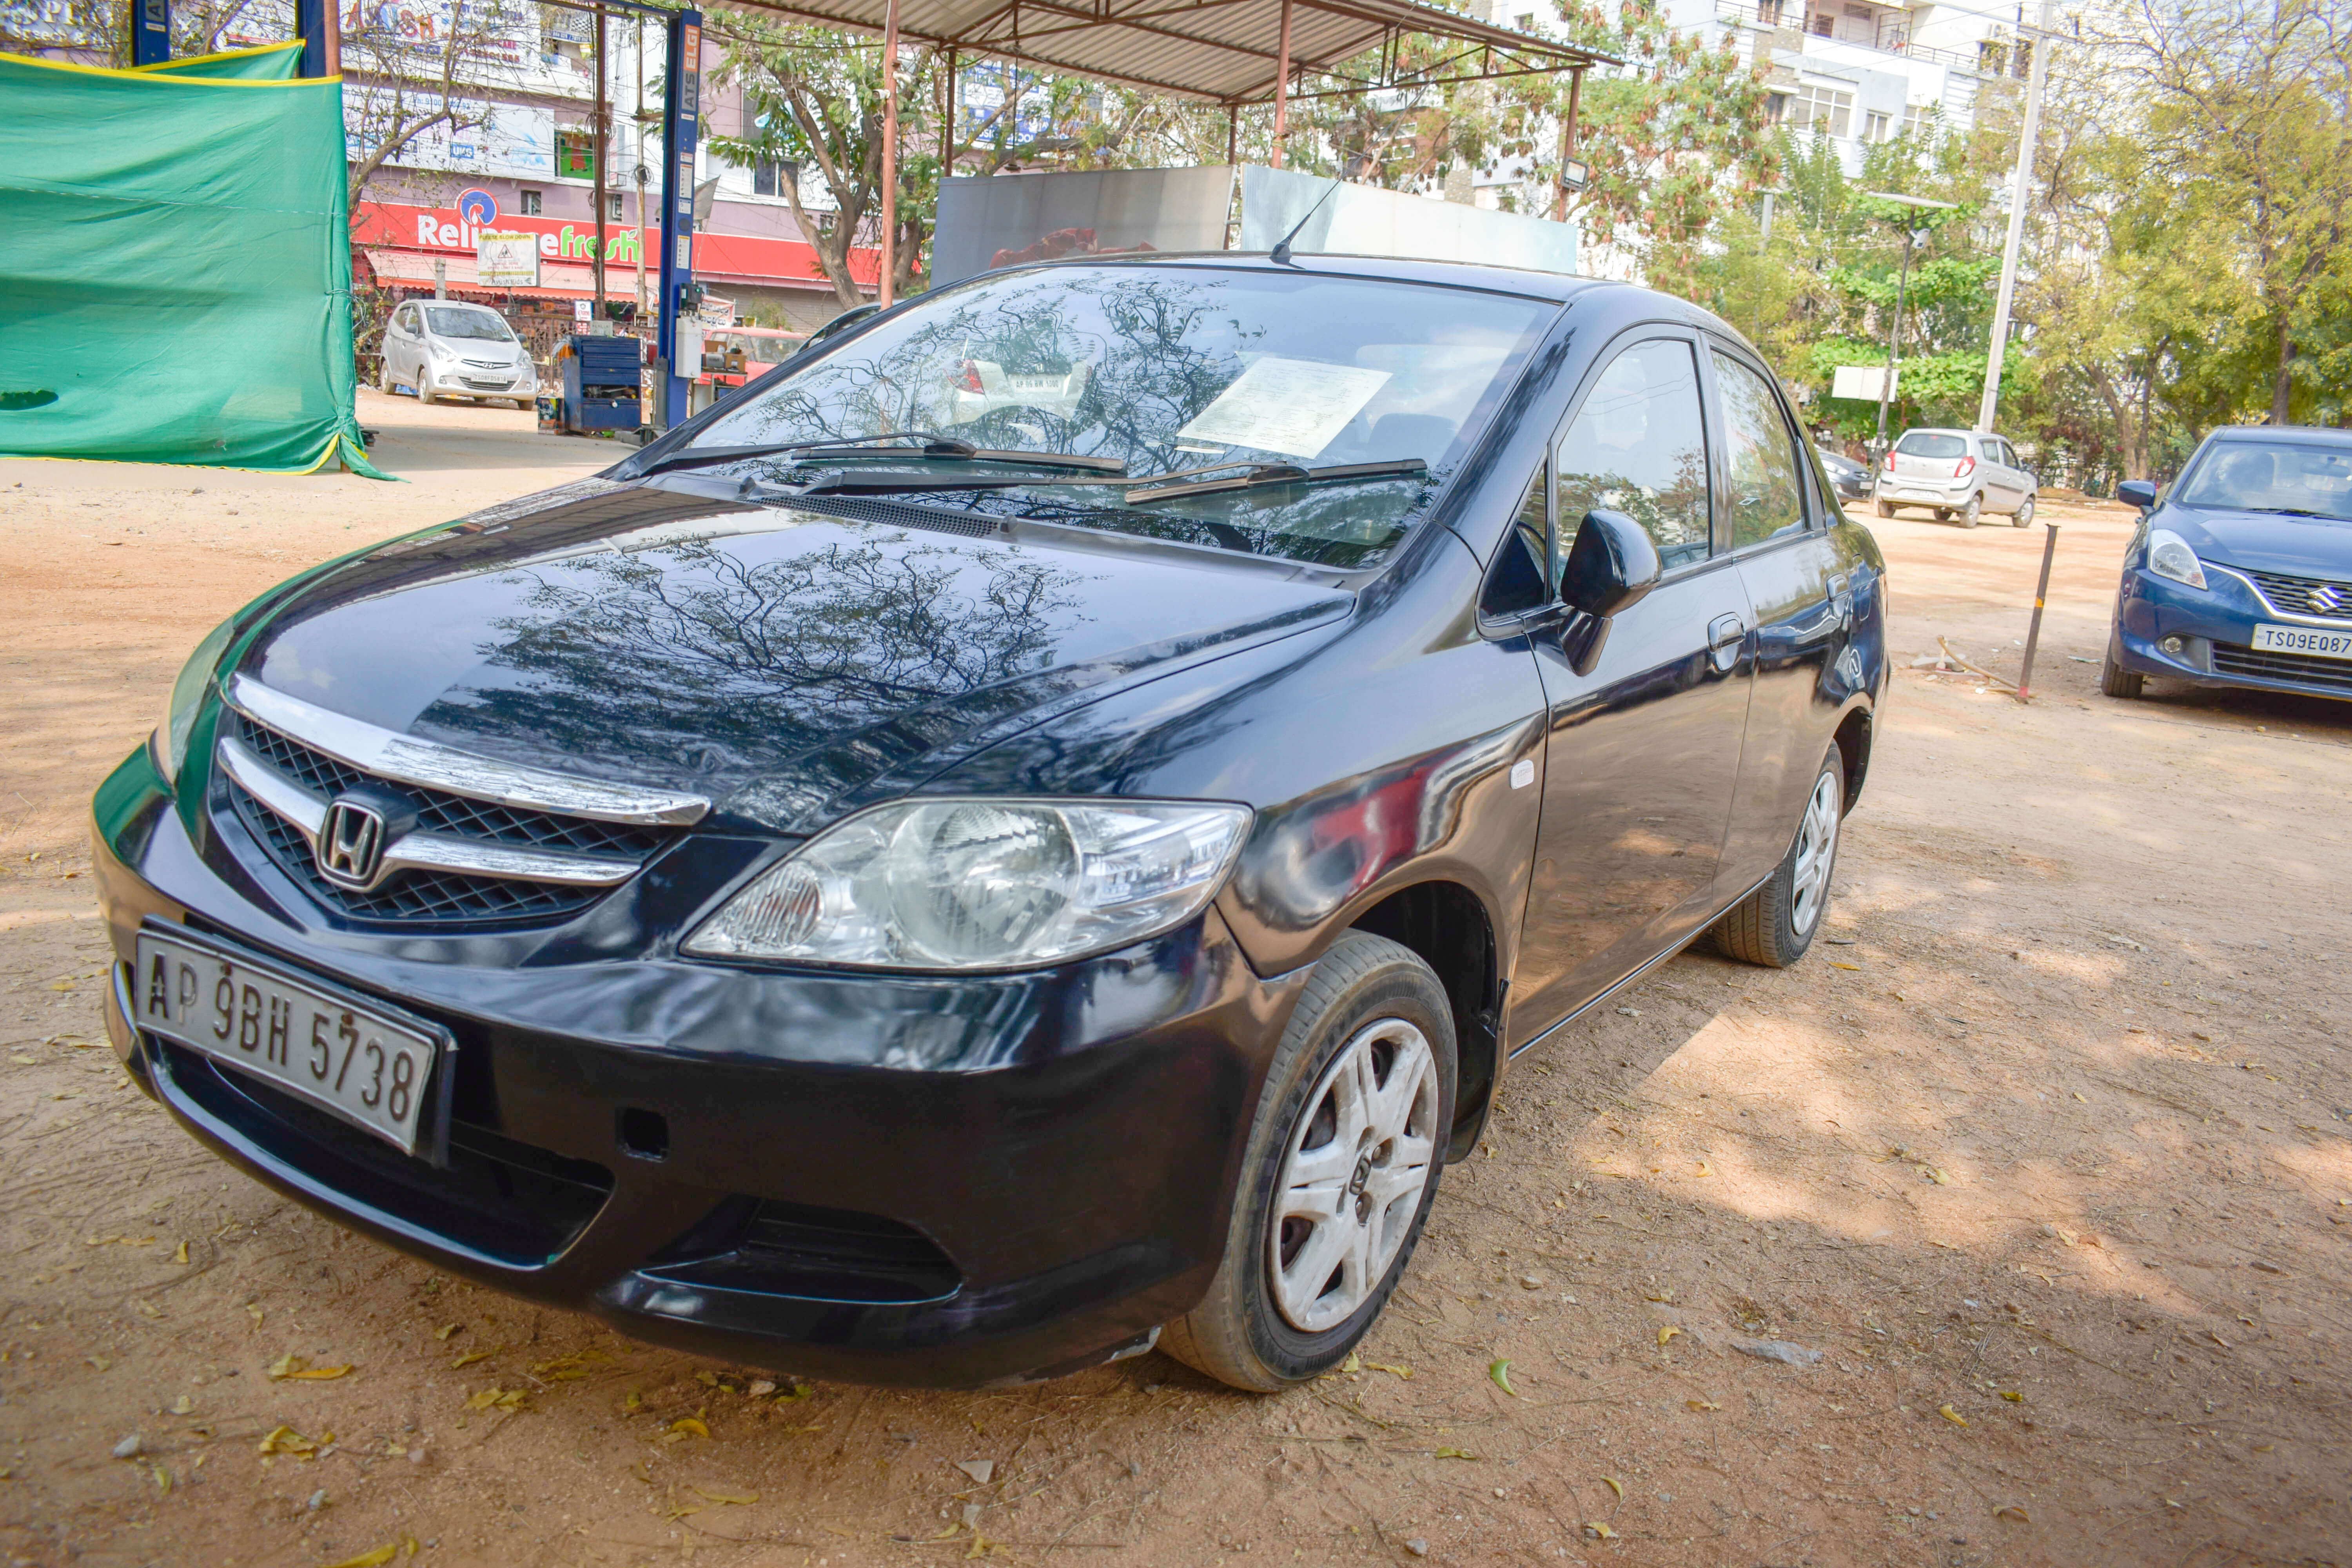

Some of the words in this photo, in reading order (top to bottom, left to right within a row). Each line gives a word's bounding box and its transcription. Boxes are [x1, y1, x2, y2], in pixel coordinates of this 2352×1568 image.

[686, 29, 698, 69] ELGI
[684, 73, 695, 108] ATS
[417, 214, 559, 256] Relie
[149, 950, 198, 1024] AP
[213, 975, 292, 1067] 9BH
[310, 1013, 414, 1122] 5738
